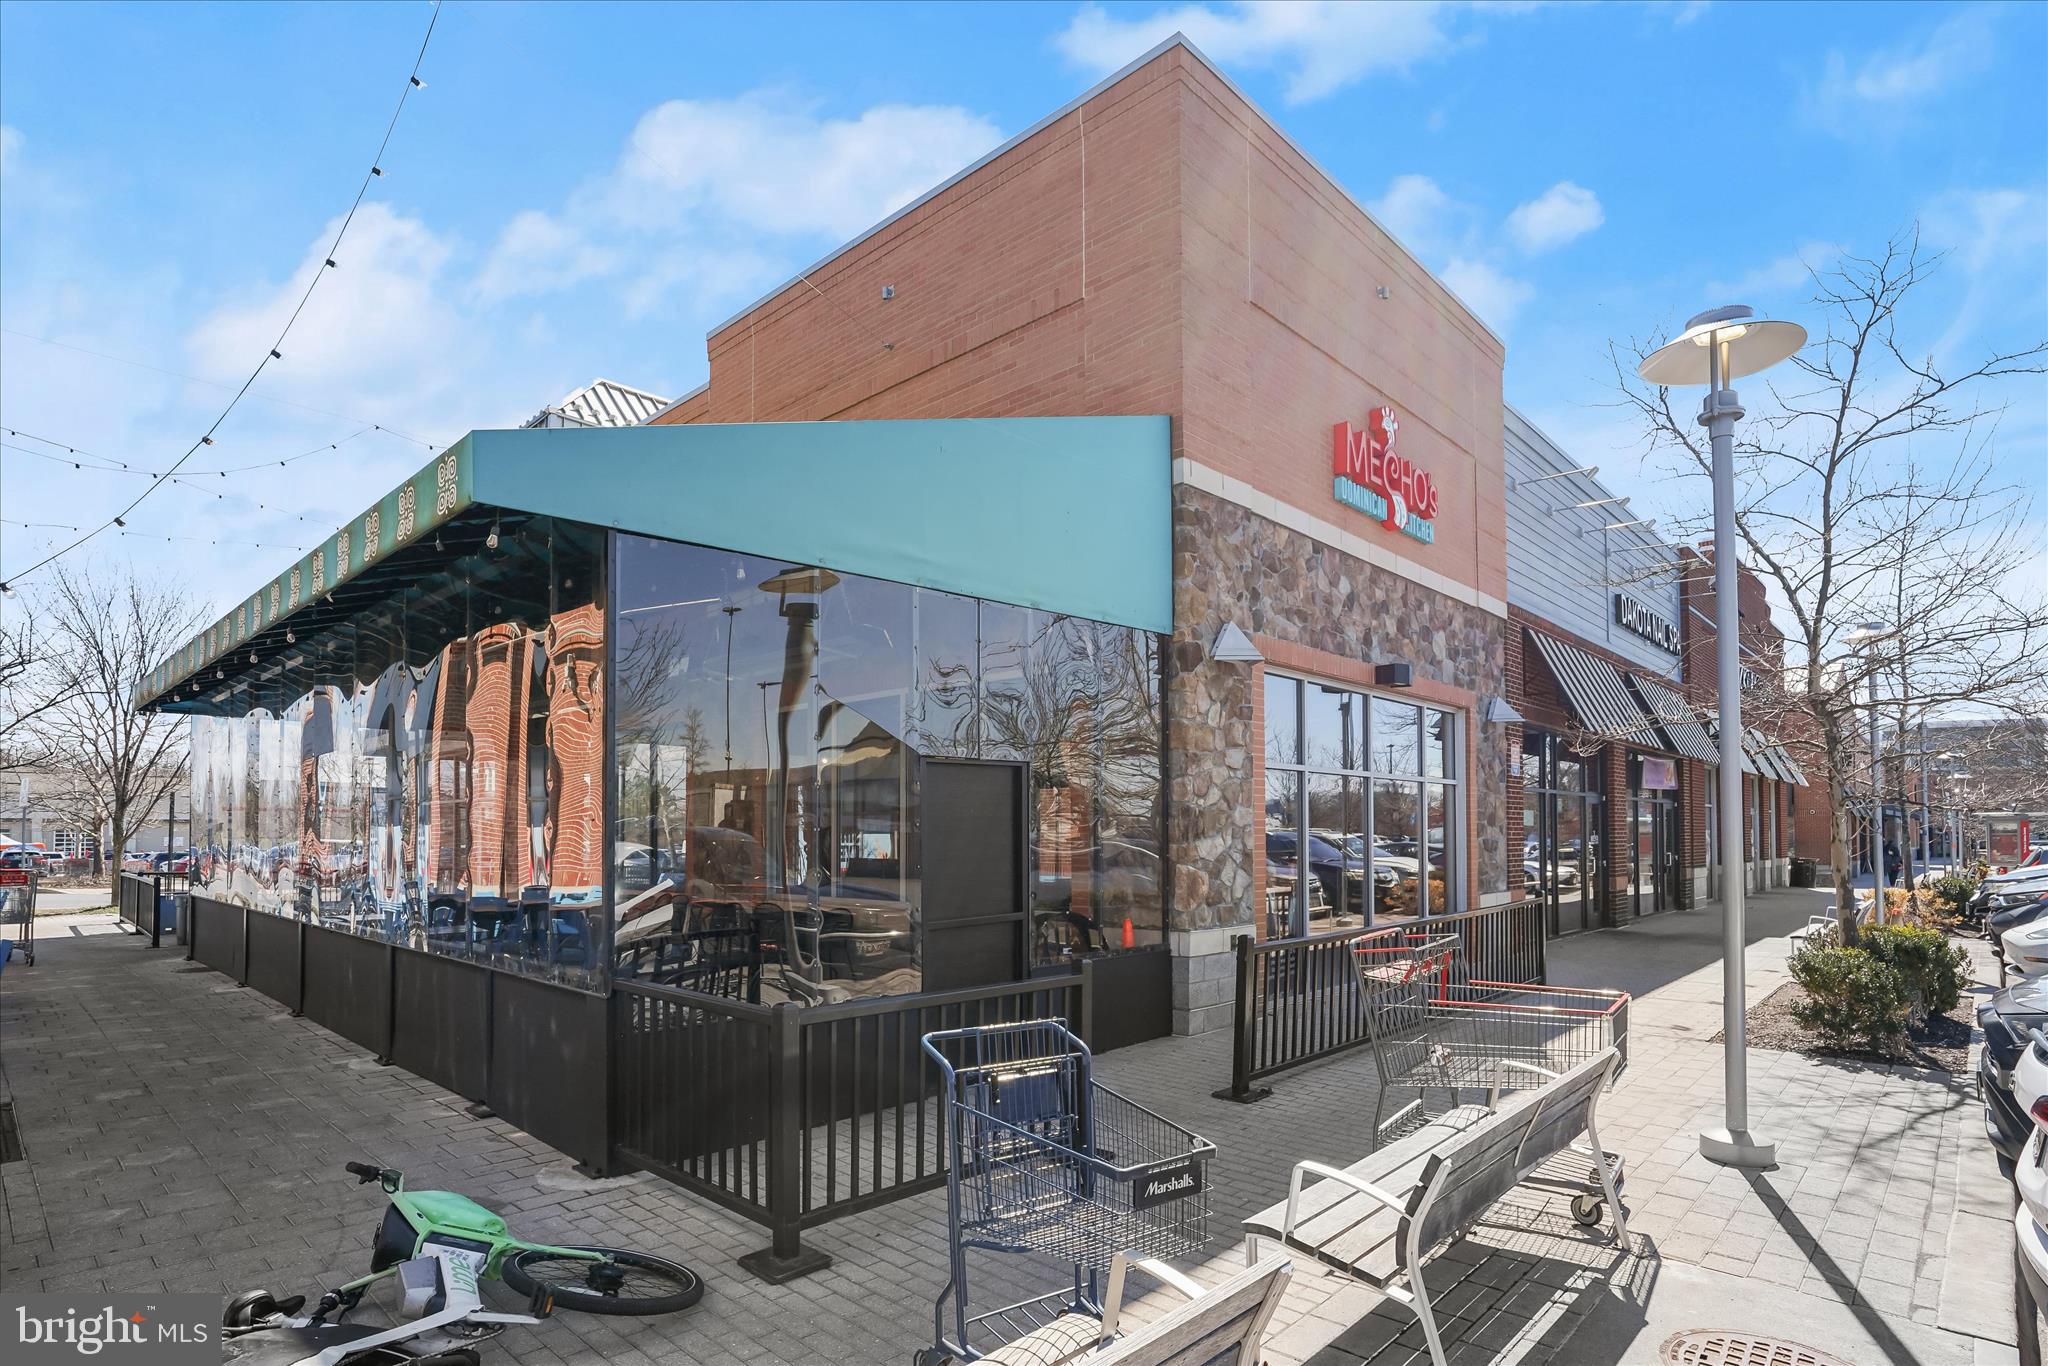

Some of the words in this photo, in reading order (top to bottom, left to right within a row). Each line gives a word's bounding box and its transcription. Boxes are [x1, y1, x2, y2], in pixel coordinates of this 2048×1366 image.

[1334, 421, 1439, 519] MECHO'S
[1619, 593, 1652, 639] DAKOTA
[1652, 612, 1668, 648] NAIL
[1669, 623, 1682, 655] SPA
[1144, 1173, 1194, 1198] Marshalls
